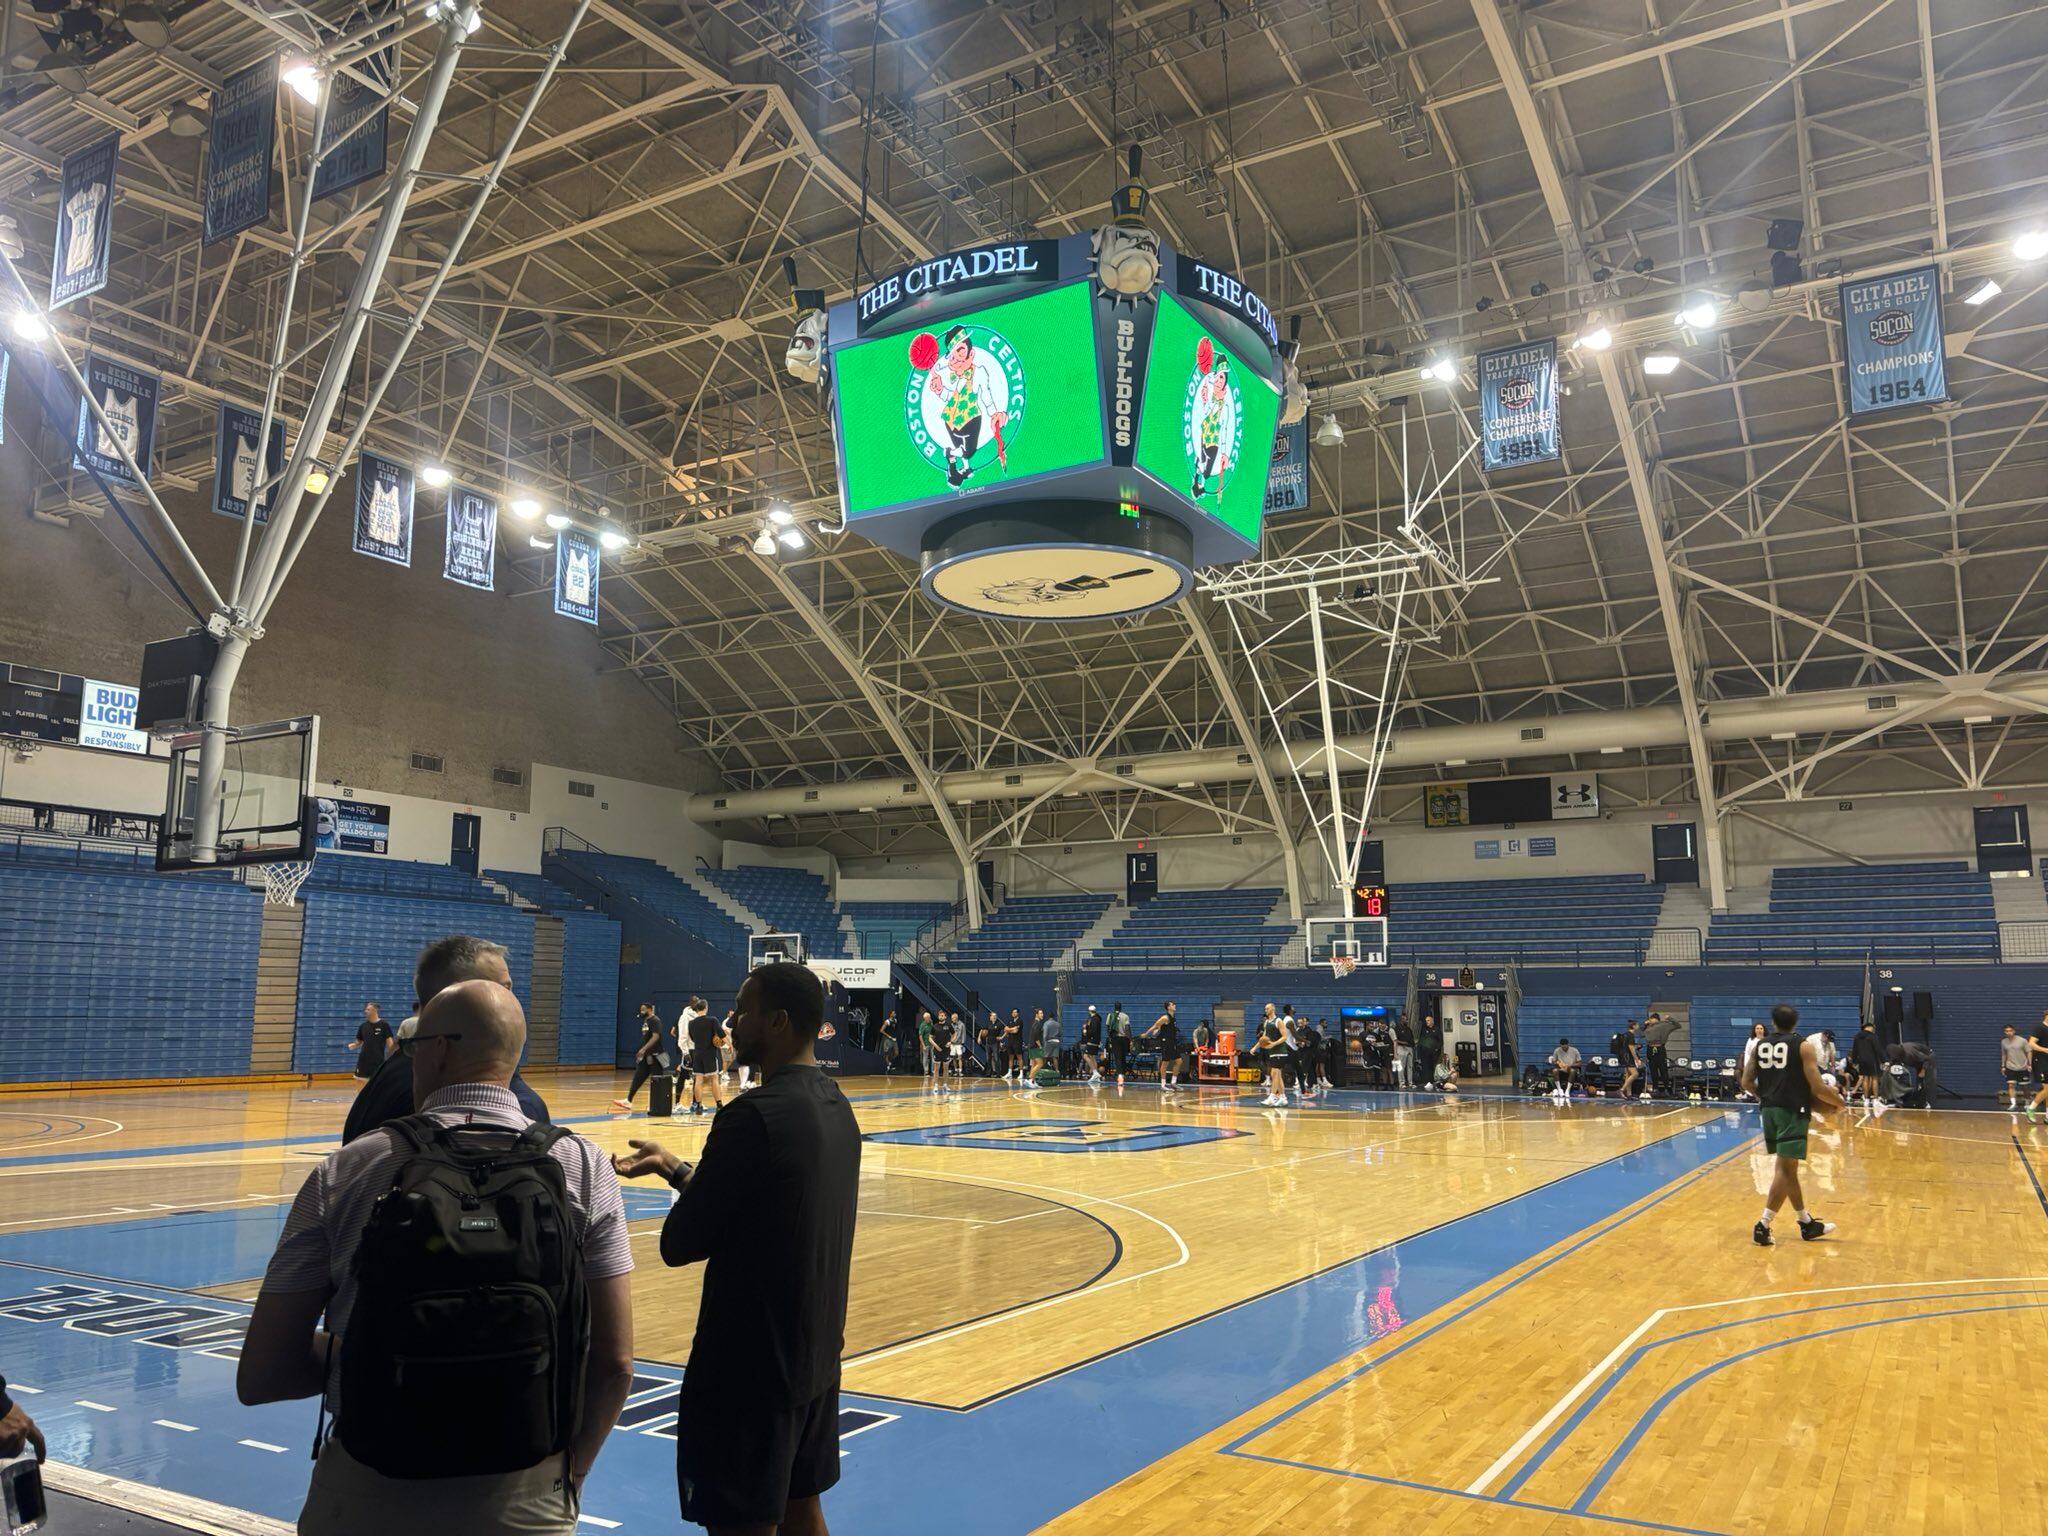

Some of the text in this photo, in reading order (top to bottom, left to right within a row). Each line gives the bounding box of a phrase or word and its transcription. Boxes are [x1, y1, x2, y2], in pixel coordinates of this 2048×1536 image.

[211, 150, 264, 185] CONFERENCE
[859, 246, 1039, 320] THE CITADEL
[1195, 264, 1244, 308] THE
[1850, 276, 1930, 305] CITADEL
[1853, 290, 1928, 315] MEN'S GOLF
[1870, 312, 1914, 340] SOCON
[1485, 347, 1549, 373] CITADEL
[1487, 368, 1514, 381] TRACK
[1522, 360, 1549, 375] FIELD
[1857, 350, 1935, 375] CHAMPIONS
[987, 336, 1025, 421] CELTICS
[1115, 319, 1135, 447] BULLDOGS
[1870, 377, 1926, 405] 1964
[907, 372, 938, 458] BOSTON
[1184, 367, 1202, 457] BOSTON
[1489, 409, 1552, 431] CONFERENCE
[1228, 387, 1244, 473] CELTICS
[1489, 420, 1552, 442] CHAMPIONS
[1501, 438, 1541, 462] 1961
[1268, 473, 1303, 488] MPIONS
[1271, 462, 1303, 477] ERENCE
[1265, 489, 1296, 510] 960
[97, 688, 137, 709] BUD
[15, 709, 35, 718] PLAYER
[36, 712, 48, 720] FOUL
[63, 717, 79, 725] FOULS
[87, 704, 137, 725] LIGH
[21, 730, 39, 738] MATCH
[61, 735, 77, 744] SCORE
[84, 736, 142, 751] RESPONSIBLY
[101, 730, 127, 741] ENJOY
[338, 827, 368, 836] BULLDOG
[354, 822, 374, 830] YOUR
[1368, 898, 1382, 916] 18
[1425, 973, 1436, 981] 36
[1879, 969, 1893, 979] 38
[1757, 1041, 1789, 1069] 99
